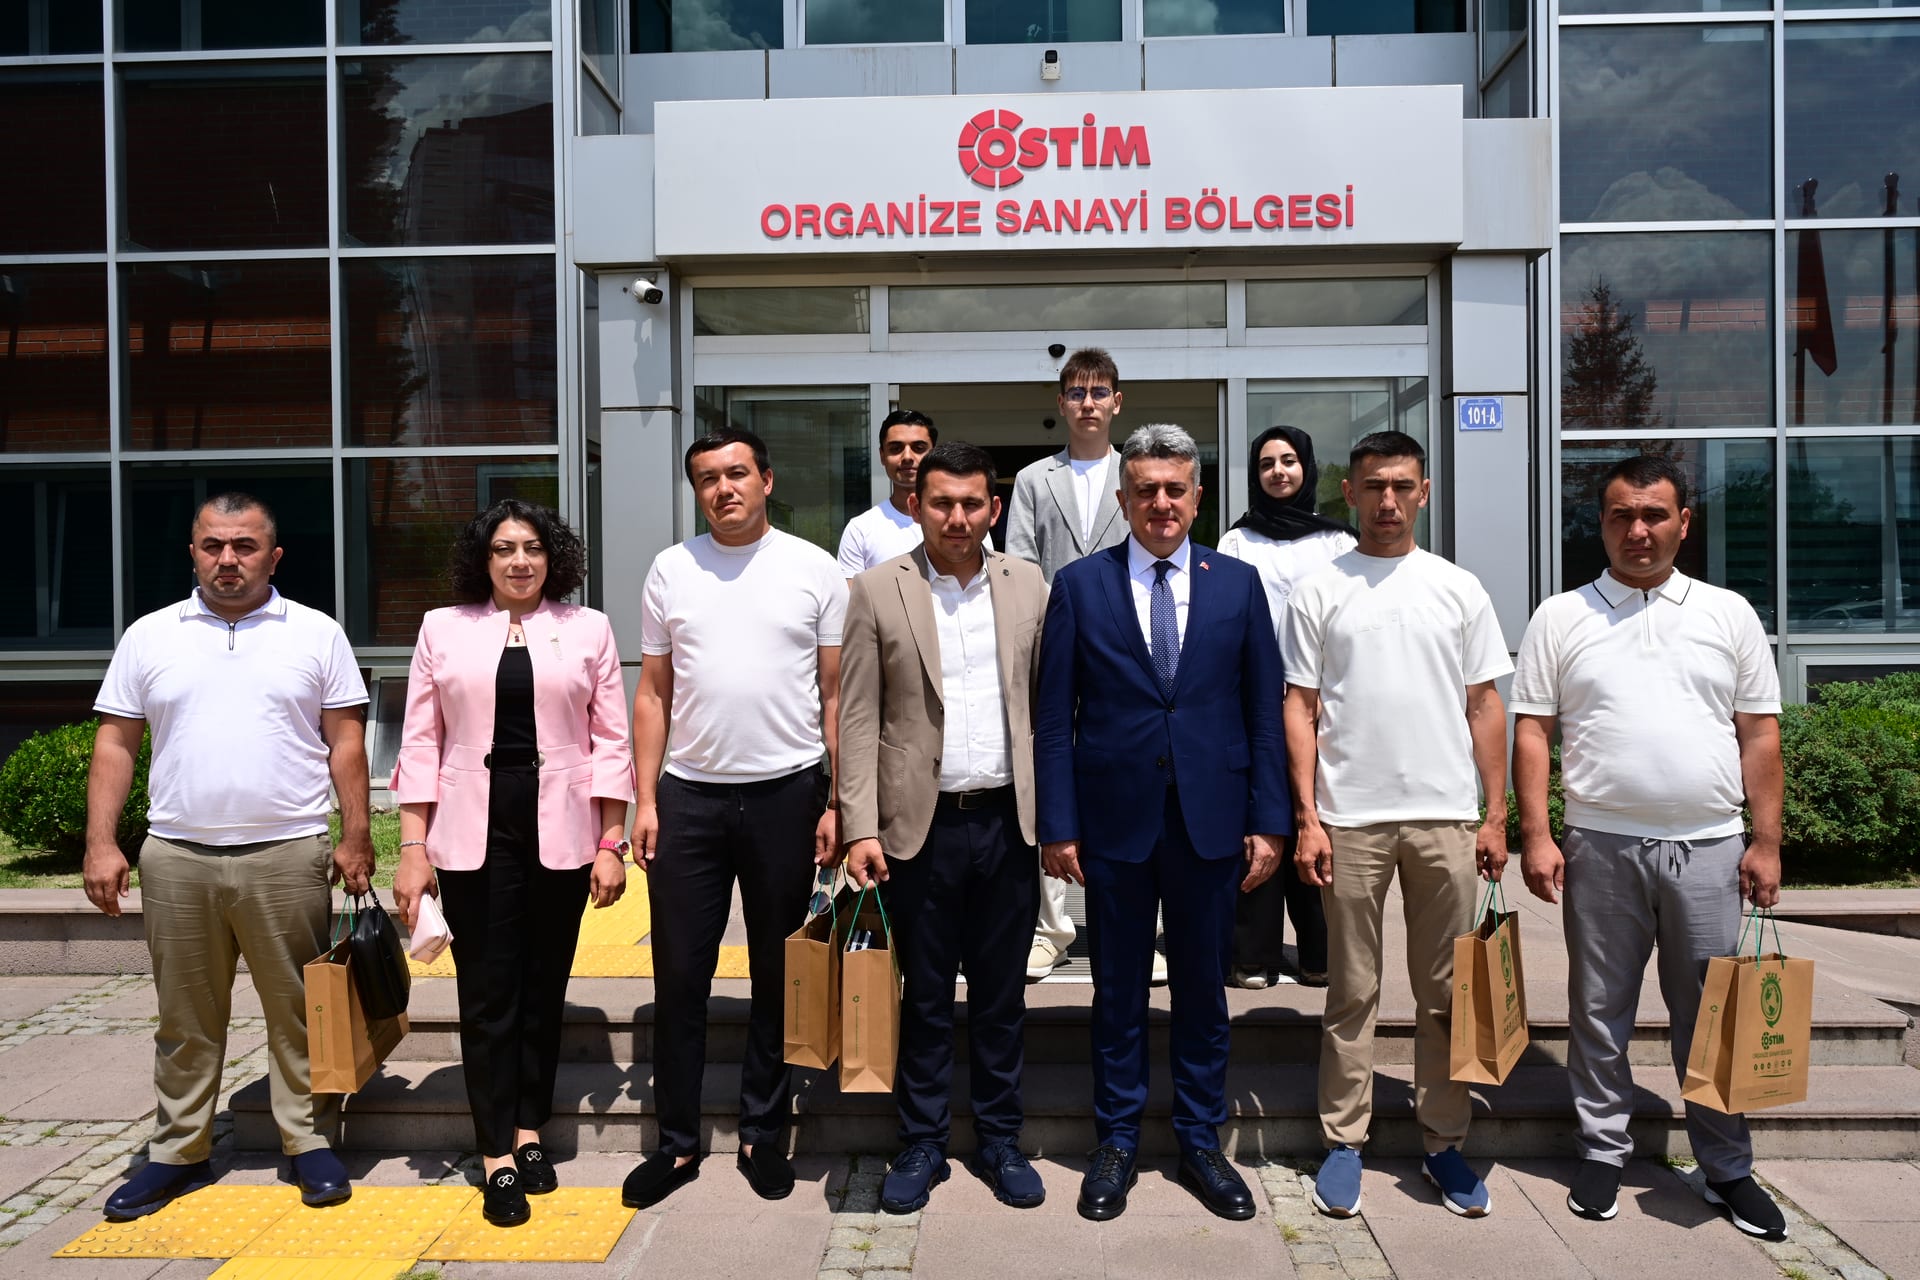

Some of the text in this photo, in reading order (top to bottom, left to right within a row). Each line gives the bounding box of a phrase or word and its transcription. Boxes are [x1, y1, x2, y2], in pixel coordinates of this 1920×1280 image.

[760, 184, 1354, 238] ORGANİZE SANAYİ BÖLGESİ
